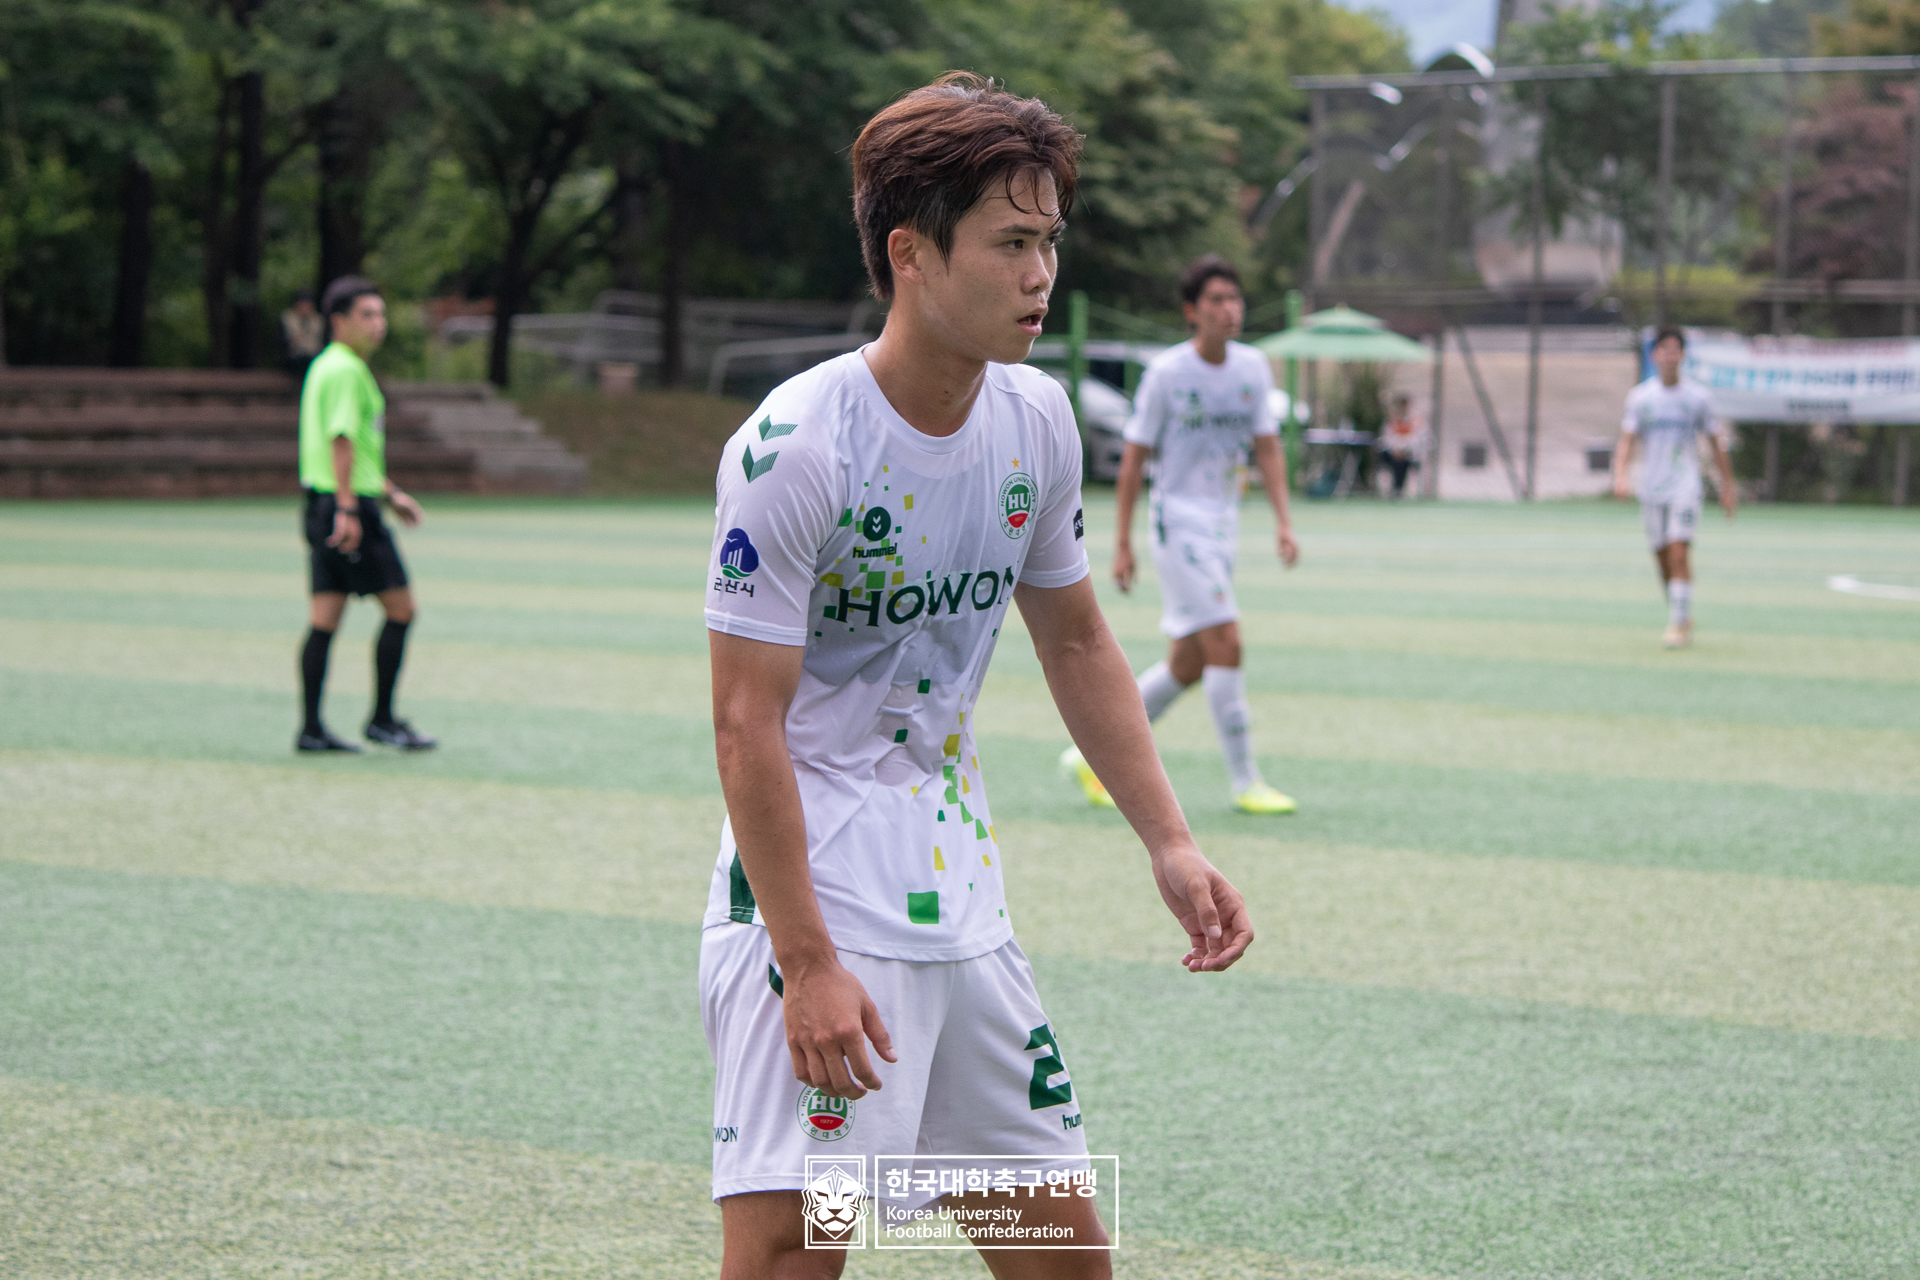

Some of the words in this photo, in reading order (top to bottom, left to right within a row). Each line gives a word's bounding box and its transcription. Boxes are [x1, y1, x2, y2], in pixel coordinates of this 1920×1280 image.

[1007, 492, 1030, 509] HU
[853, 543, 897, 558] hummel
[714, 577, 755, 598] 군산시
[1023, 1023, 1072, 1110] 2
[810, 1095, 844, 1112] HU
[713, 1126, 738, 1142] WON
